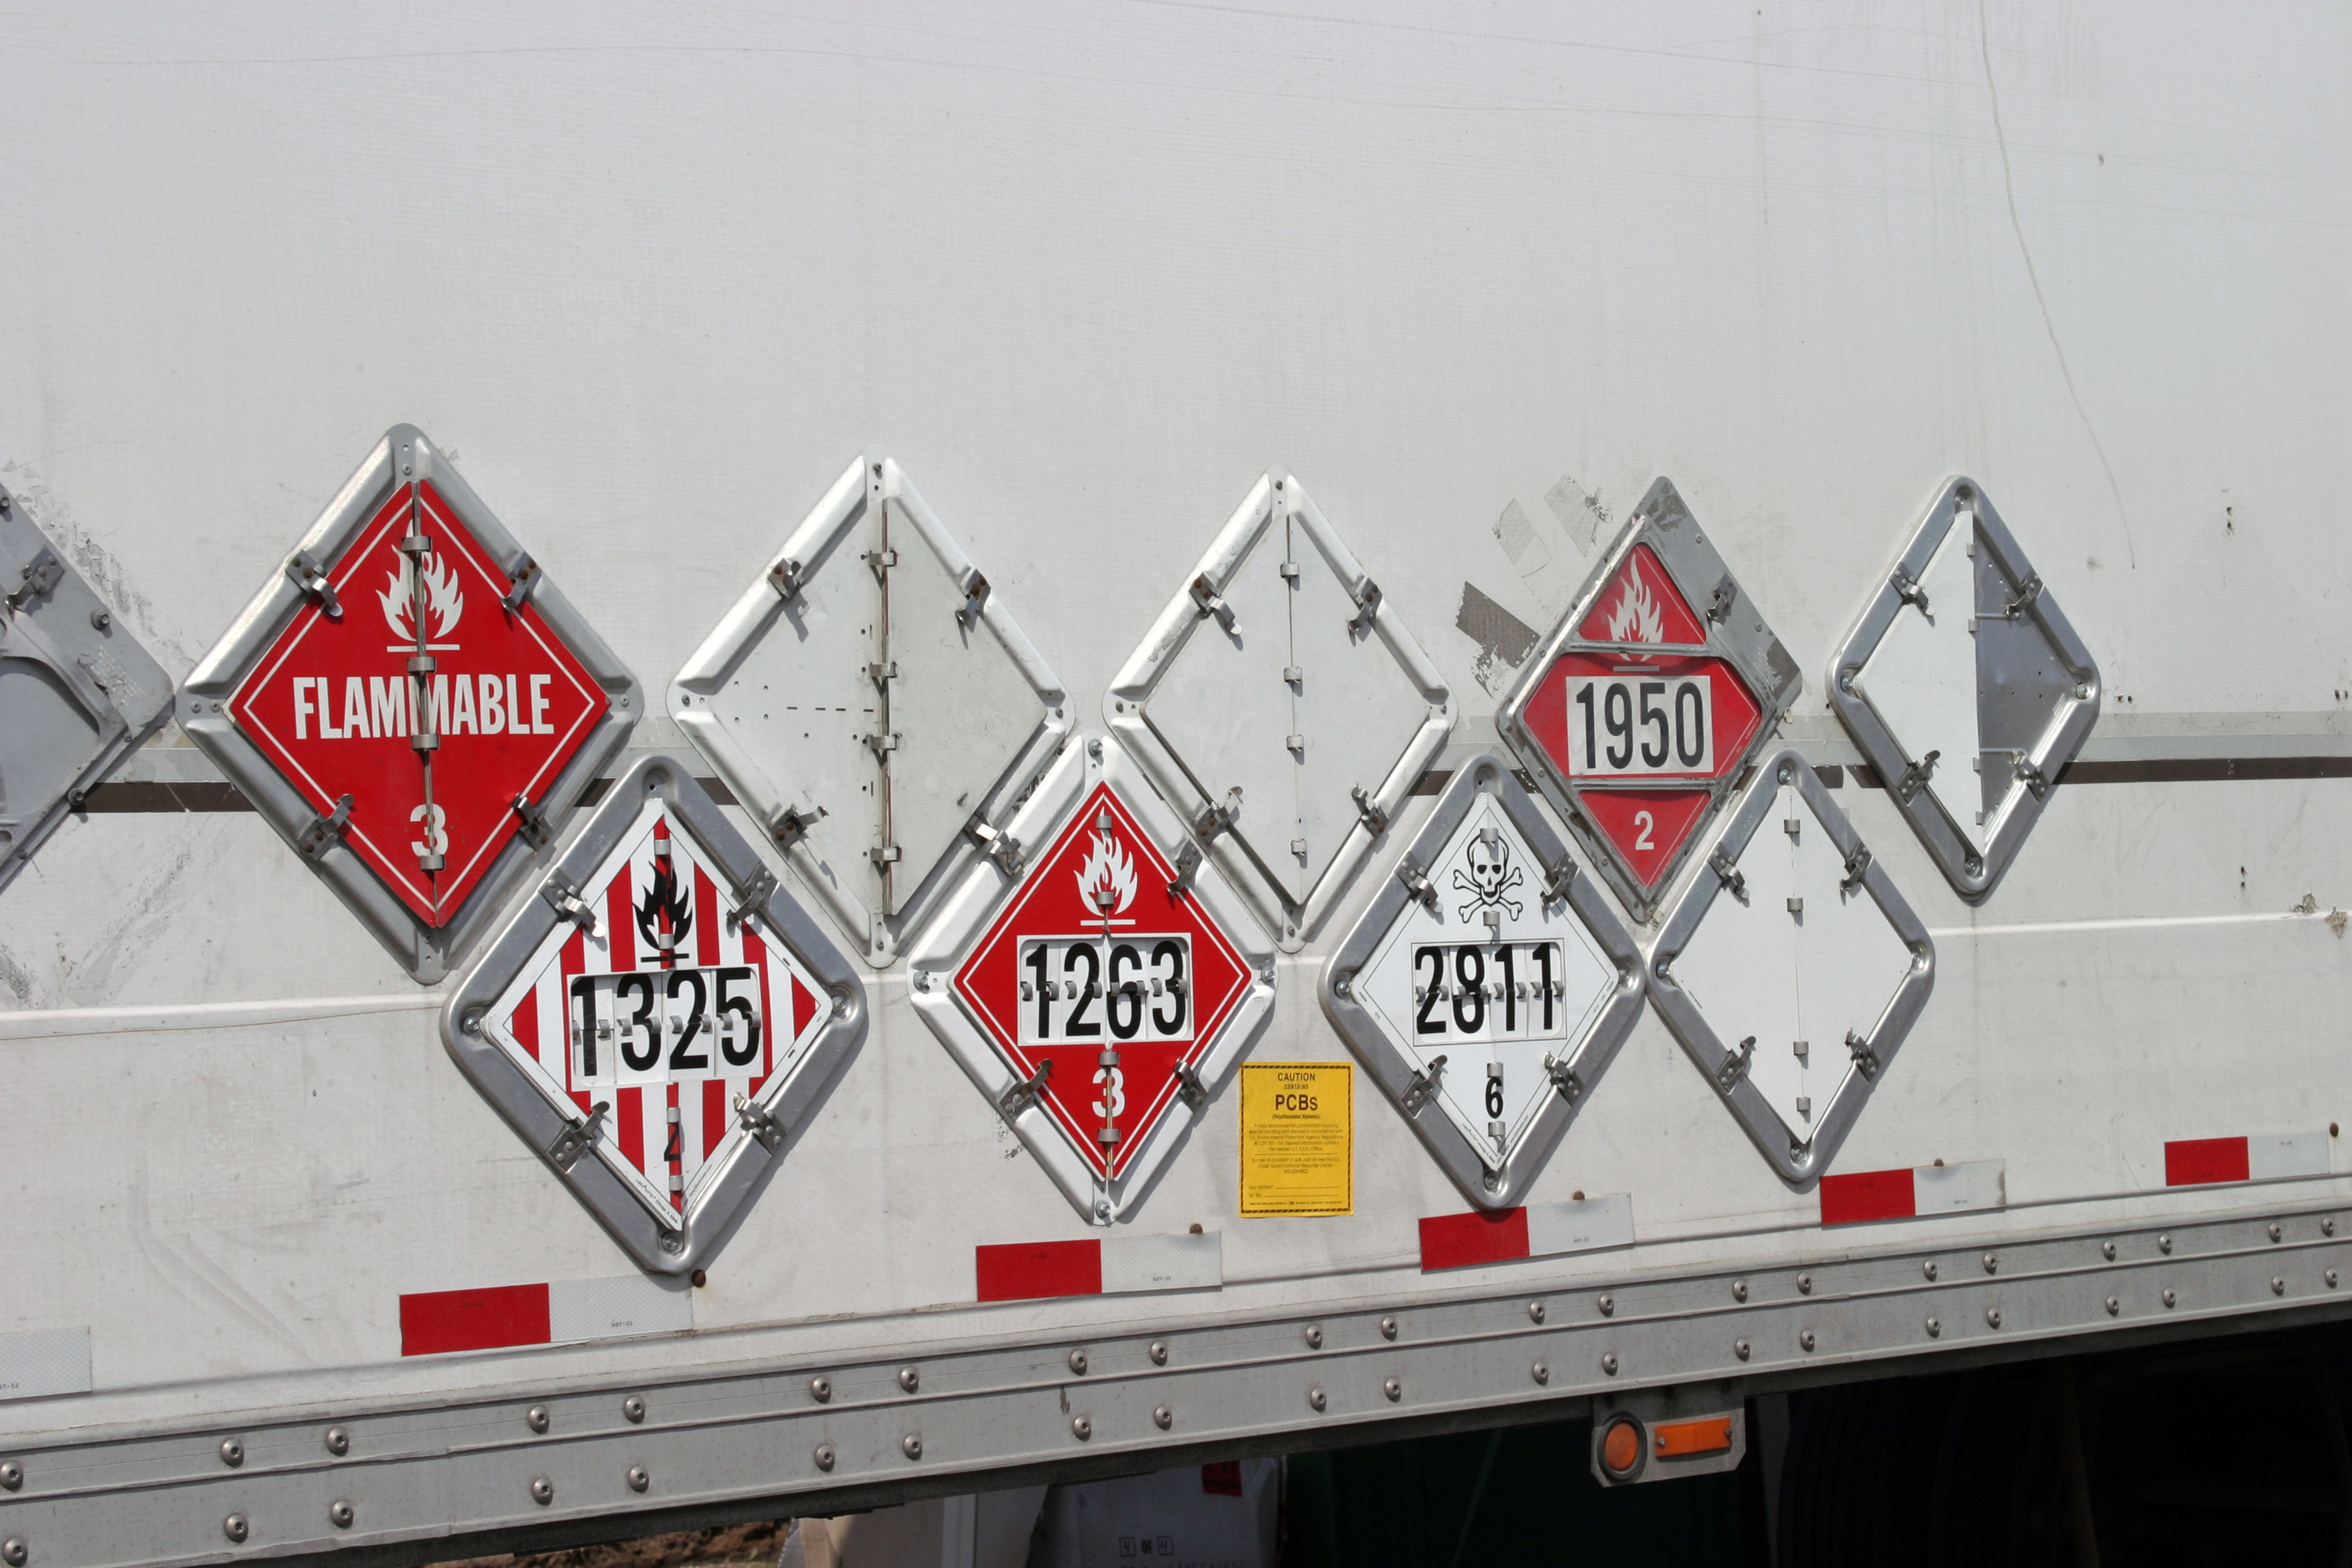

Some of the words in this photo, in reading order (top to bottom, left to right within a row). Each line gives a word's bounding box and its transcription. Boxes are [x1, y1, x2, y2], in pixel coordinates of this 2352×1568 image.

[292, 674, 554, 739] FLAMMABLE
[1576, 681, 1704, 769] 1950
[410, 803, 449, 858] 3
[1635, 810, 1655, 851] 2
[1026, 940, 1185, 1040] 1263
[1414, 942, 1553, 1034] 2811
[571, 966, 762, 1076] 1325
[1092, 1067, 1125, 1118] 3
[1276, 1094, 1318, 1111] PCBs
[1278, 1073, 1315, 1081] CAUTION
[1485, 1076, 1504, 1119] 6
[1142, 1540, 1152, 1554] OF
